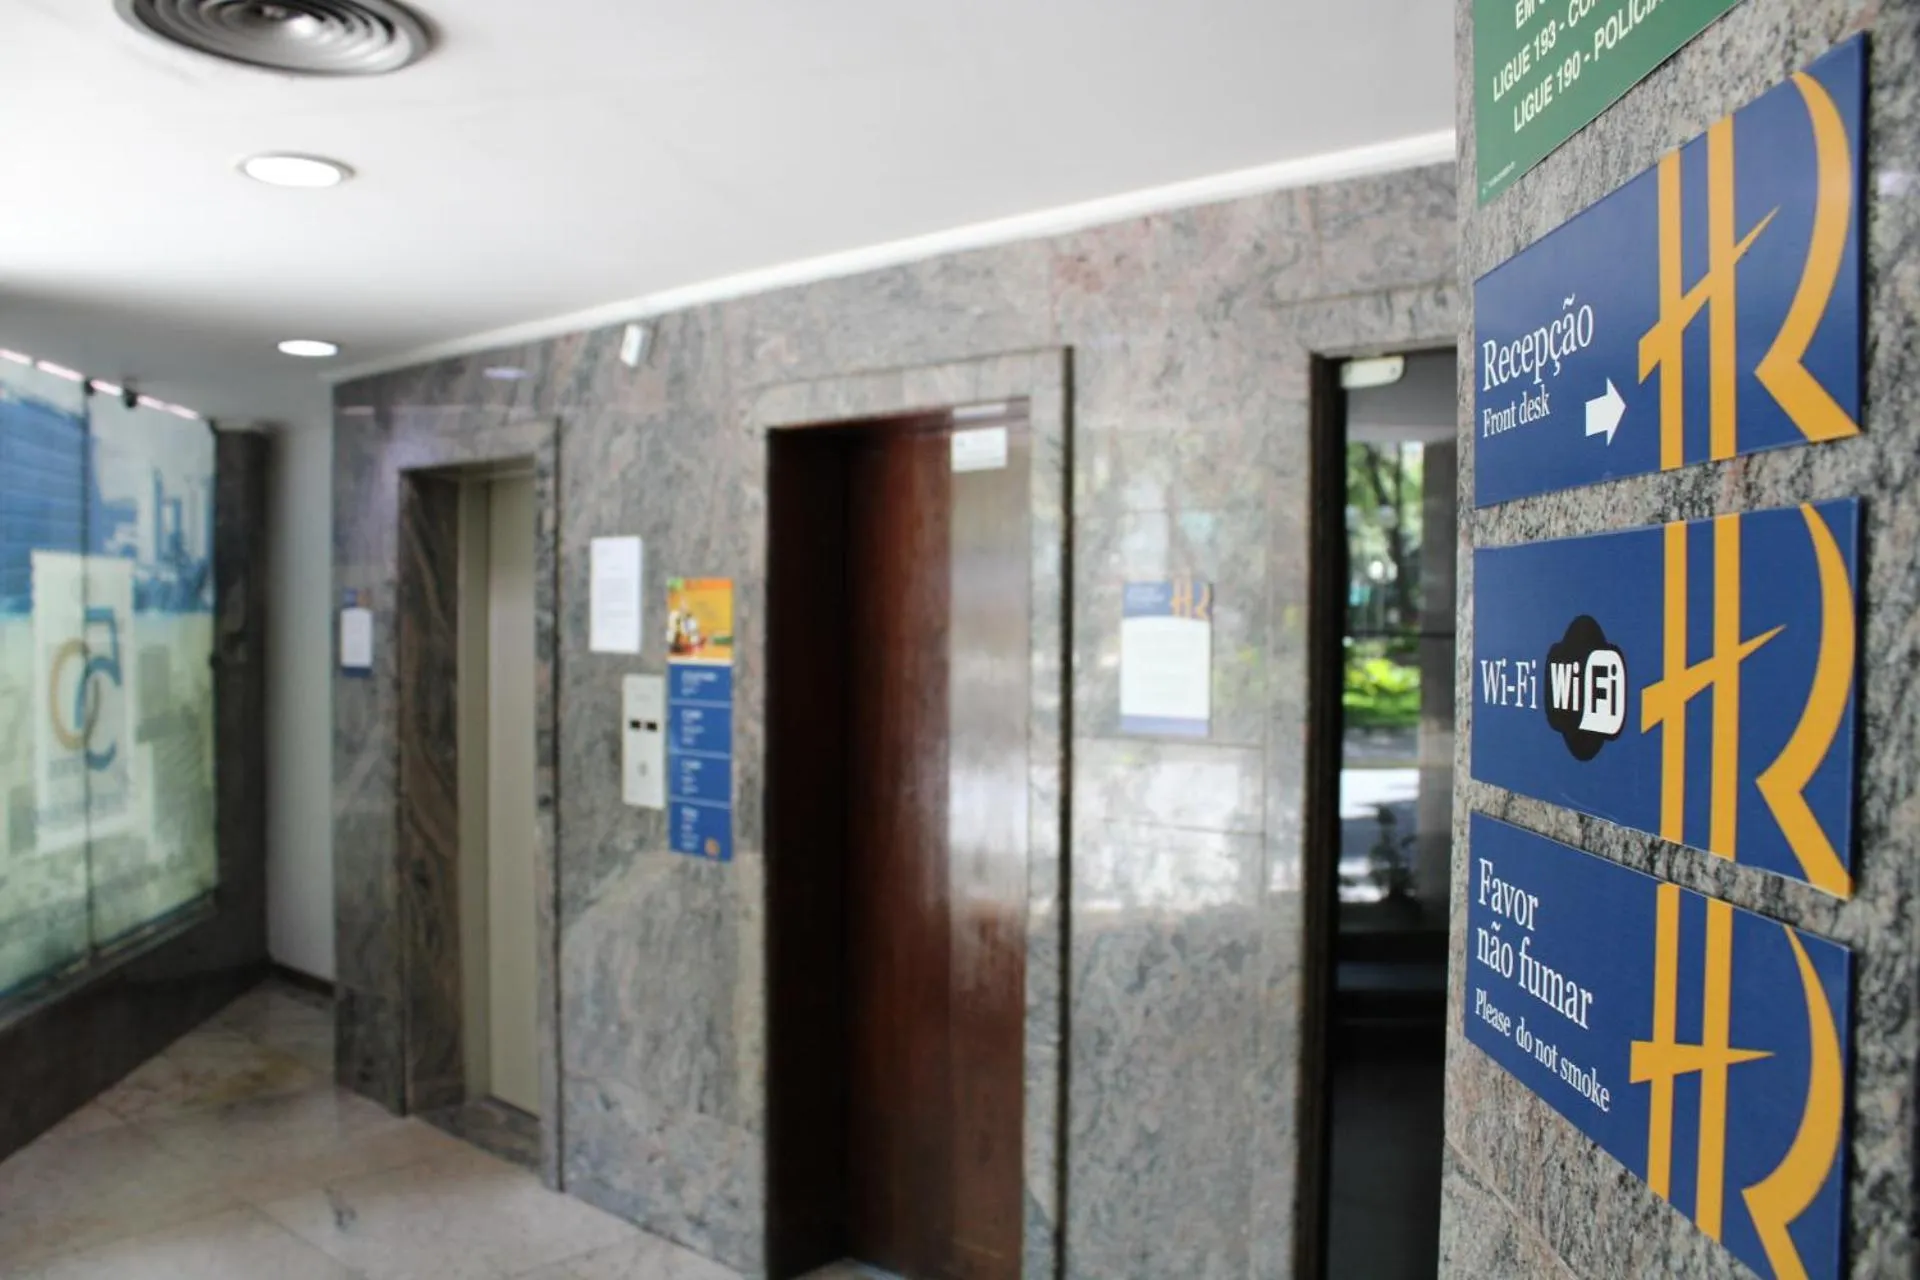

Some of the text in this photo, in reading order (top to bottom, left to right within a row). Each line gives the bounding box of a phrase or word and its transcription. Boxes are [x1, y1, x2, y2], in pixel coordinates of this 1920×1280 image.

[1493, 43, 1531, 103] LIGUE
[1533, 19, 1556, 62] 193
[1568, 0, 1596, 28] CO
[1514, 73, 1553, 134] LIGUE
[1556, 50, 1580, 94] 190
[1482, 293, 1595, 391] Recepção
[1482, 384, 1551, 438] Front desk
[1480, 658, 1538, 709] Wi-Fi
[1478, 857, 1539, 932] Favor
[1476, 921, 1594, 1030] não fumar
[1474, 987, 1611, 1113] Please do not smoke
